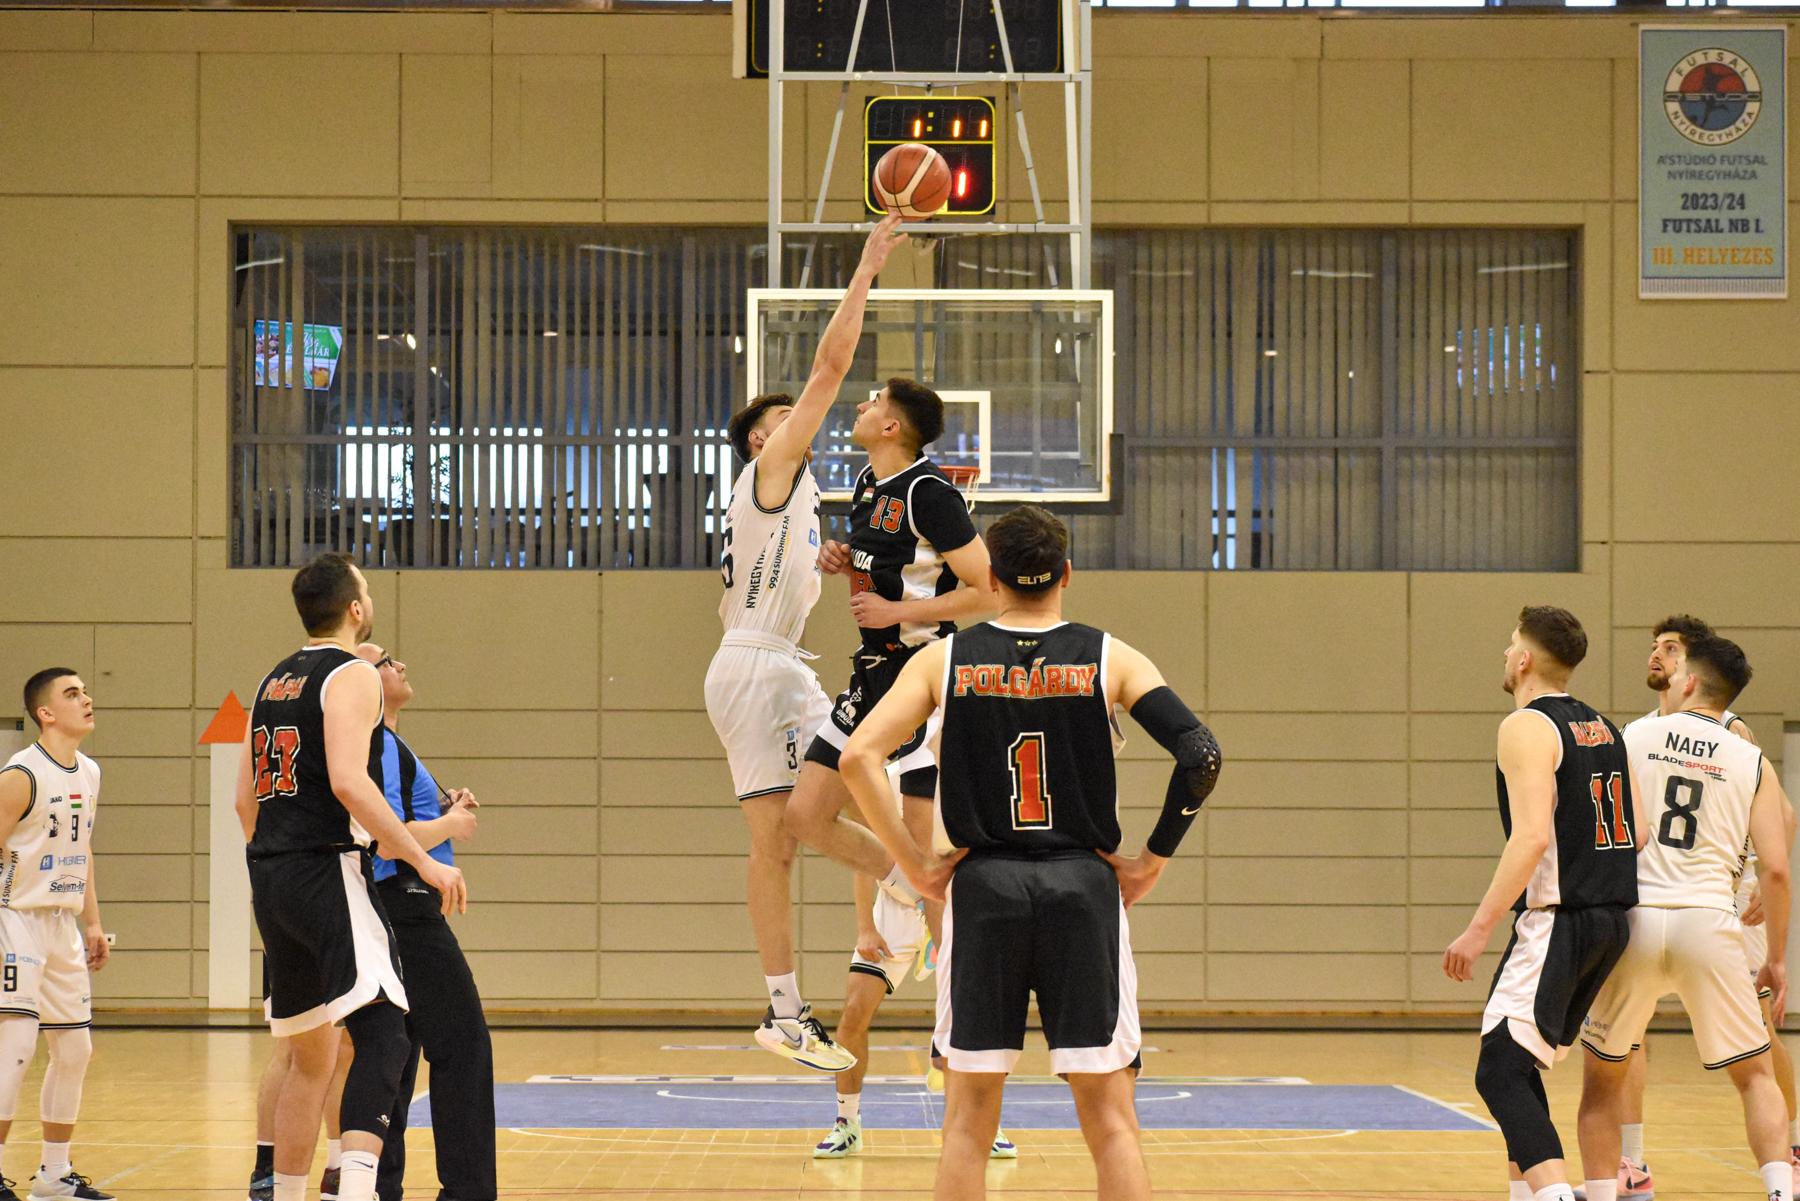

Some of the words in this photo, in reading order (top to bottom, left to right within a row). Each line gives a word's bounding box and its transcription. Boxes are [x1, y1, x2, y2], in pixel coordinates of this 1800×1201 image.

[1675, 52, 1749, 77] FUTSAL
[1667, 167, 1758, 180] NYÍREGYHÁZA
[1720, 155, 1768, 166] FUTSAL
[1681, 193, 1746, 211] 2023/24
[1662, 218, 1724, 233] FUTSAL
[1728, 218, 1750, 233] NB
[870, 495, 905, 534] 13
[768, 568, 780, 590] 99.4
[774, 530, 788, 569] SUNSHINE
[783, 515, 791, 530] FM
[954, 657, 1097, 698] POLGÁRDY
[1665, 732, 1719, 758] NAGY
[1648, 753, 1725, 775] BLADESPORT
[1008, 732, 1052, 830] 1
[1590, 772, 1634, 850] 11
[1658, 775, 1704, 851] 8
[71, 815, 79, 842] 9
[4, 965, 17, 992] 9
